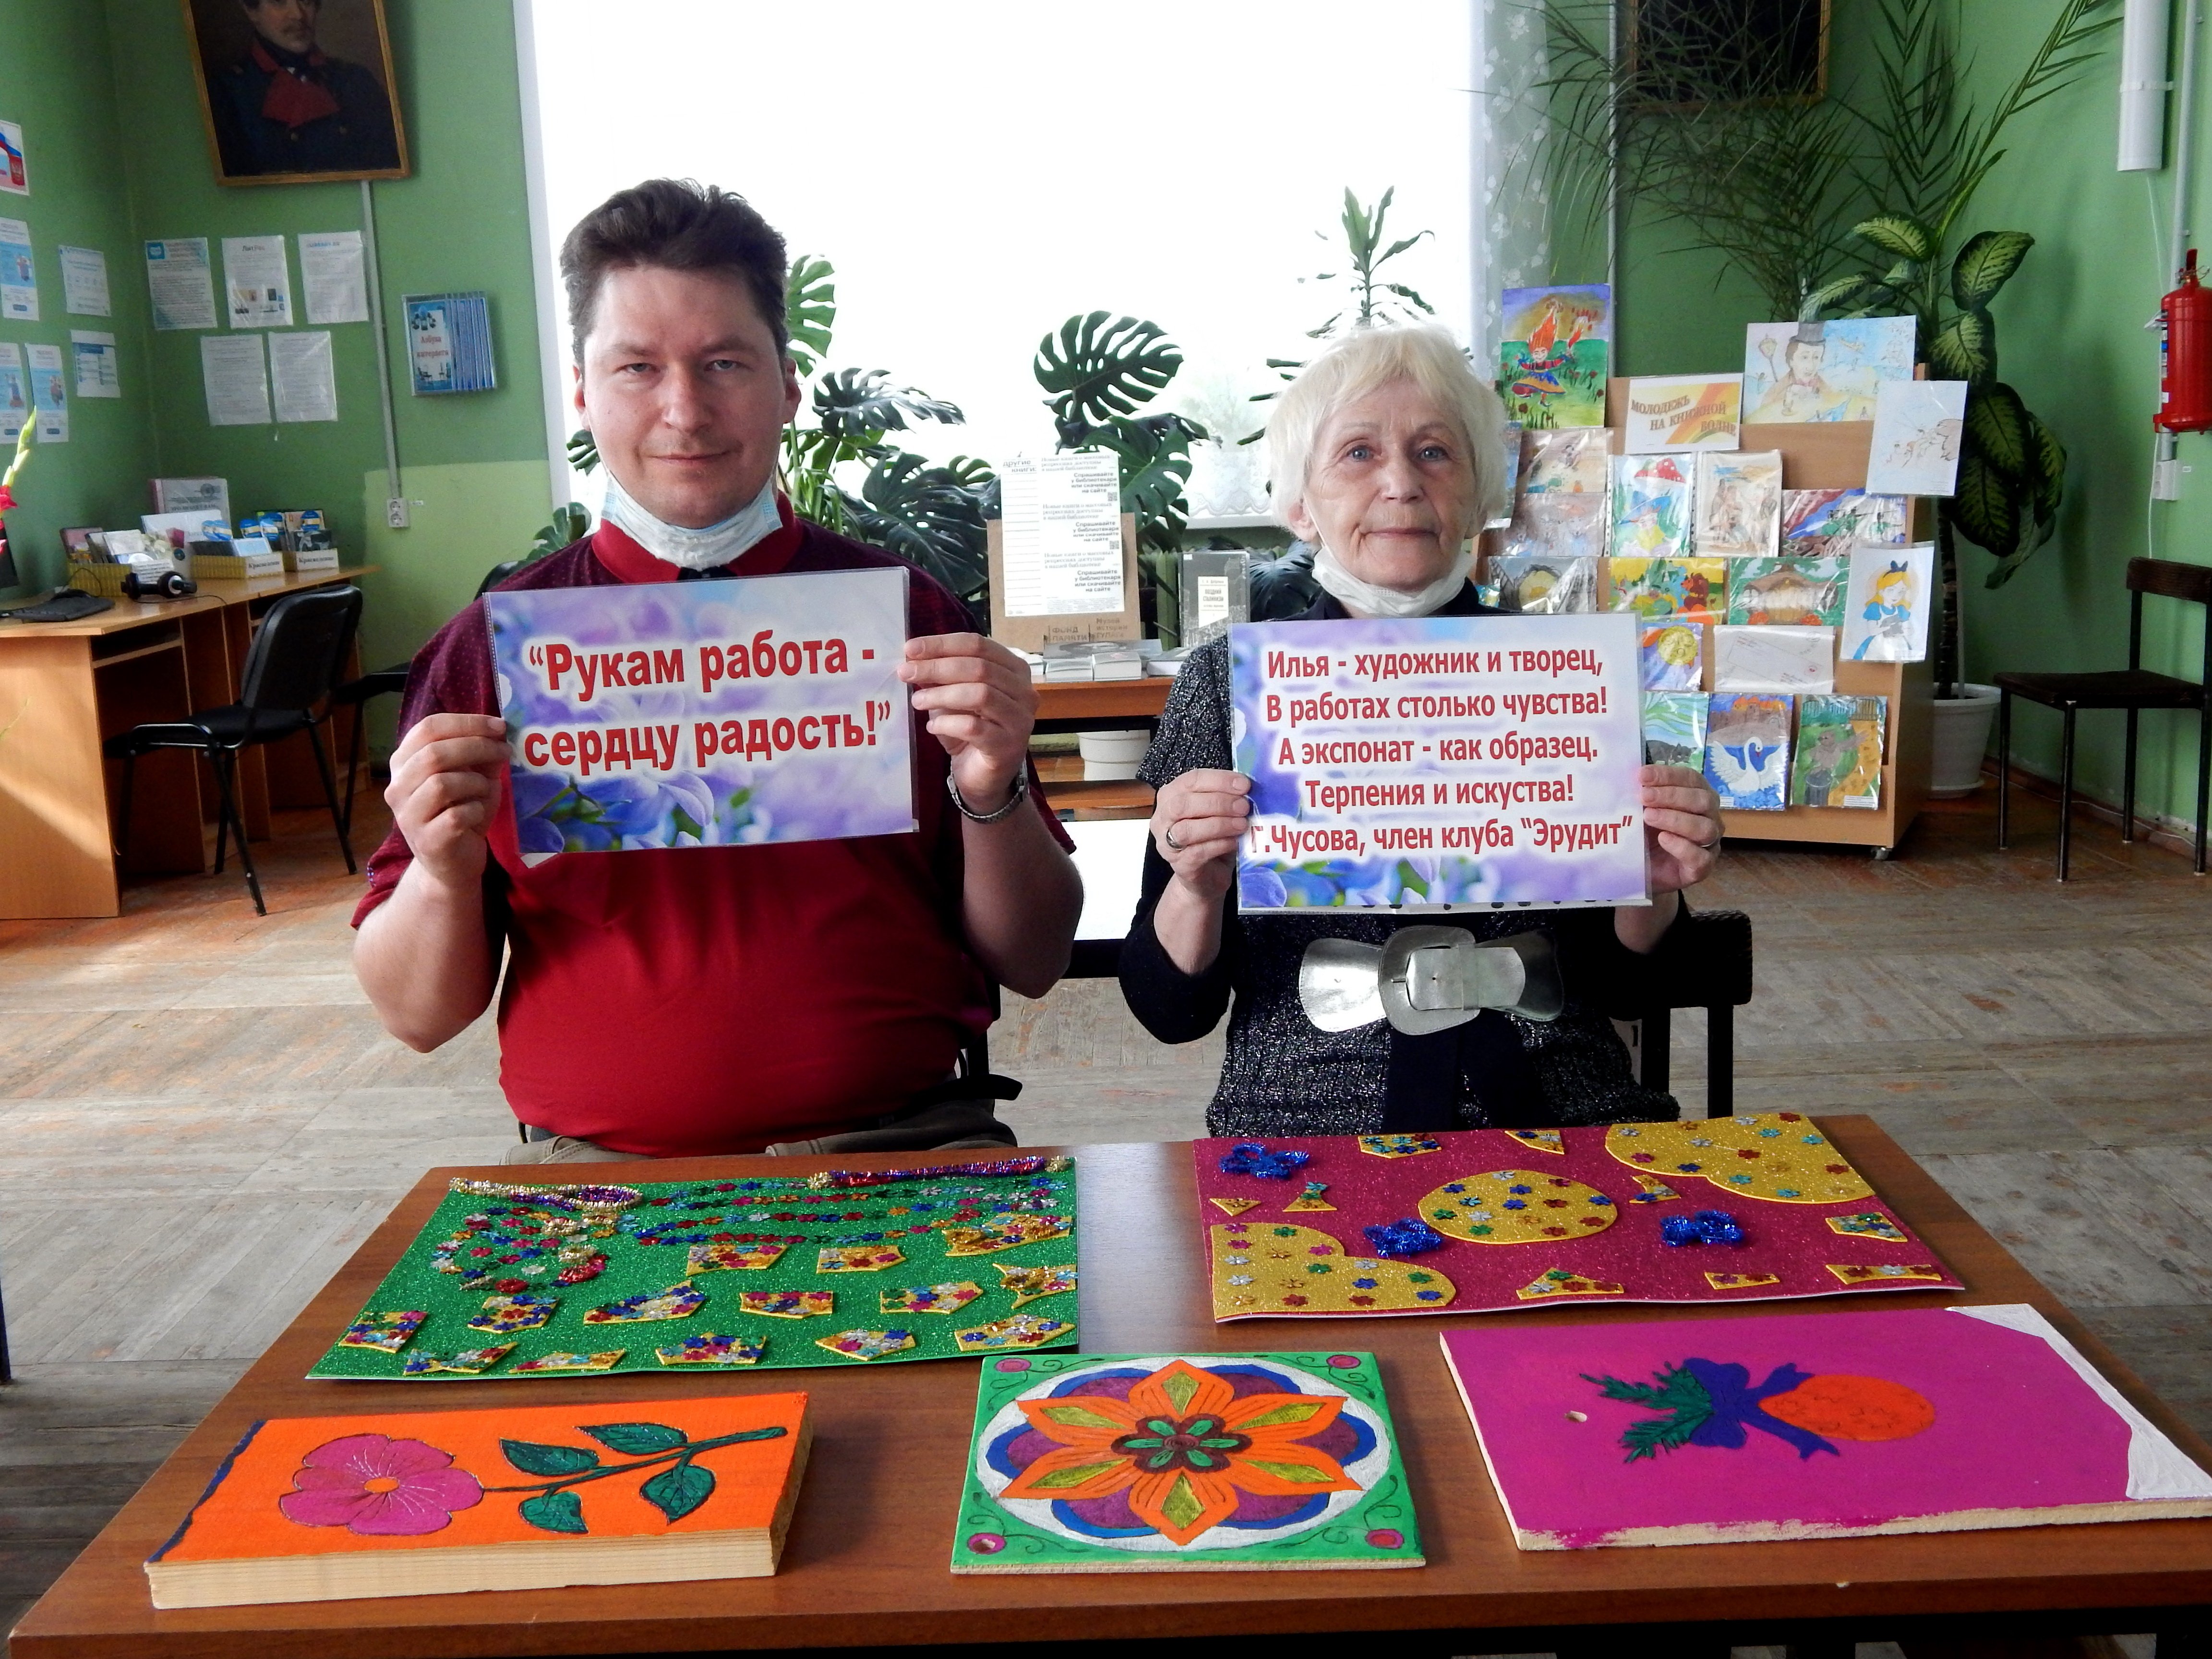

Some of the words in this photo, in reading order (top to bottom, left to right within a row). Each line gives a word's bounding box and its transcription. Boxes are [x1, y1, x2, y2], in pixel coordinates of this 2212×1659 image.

[1631, 395, 1690, 416] МОЛОДЕЖЬ
[1650, 418, 1666, 431] НА
[1669, 401, 1727, 427] КНИЖНОЙ
[1700, 419, 1736, 436] ВОЛНЕ
[1003, 459, 1031, 468] другие
[529, 643, 685, 702] “Рукам
[699, 629, 848, 693] работа
[862, 649, 875, 660] -
[1268, 651, 1329, 678] Илья
[1355, 652, 1479, 683] художник
[1487, 652, 1502, 672] и
[1509, 649, 1603, 675] творец,
[1266, 695, 1282, 722] В
[1290, 692, 1390, 728] работах
[1397, 695, 1496, 719] столько
[1503, 686, 1607, 722] чувства!
[523, 724, 680, 776] сердцу
[694, 700, 891, 768] радость!”
[1278, 738, 1295, 765] А
[1301, 740, 1415, 765] экспонат
[1440, 739, 1482, 761] как
[1489, 731, 1598, 766] образец.
[1305, 780, 1425, 814] Терпения
[1433, 784, 1448, 805] и
[1456, 774, 1574, 810] искуства!
[1250, 825, 1366, 859] Г.Чусова,
[1373, 828, 1433, 850] член
[1441, 818, 1514, 854] клуба
